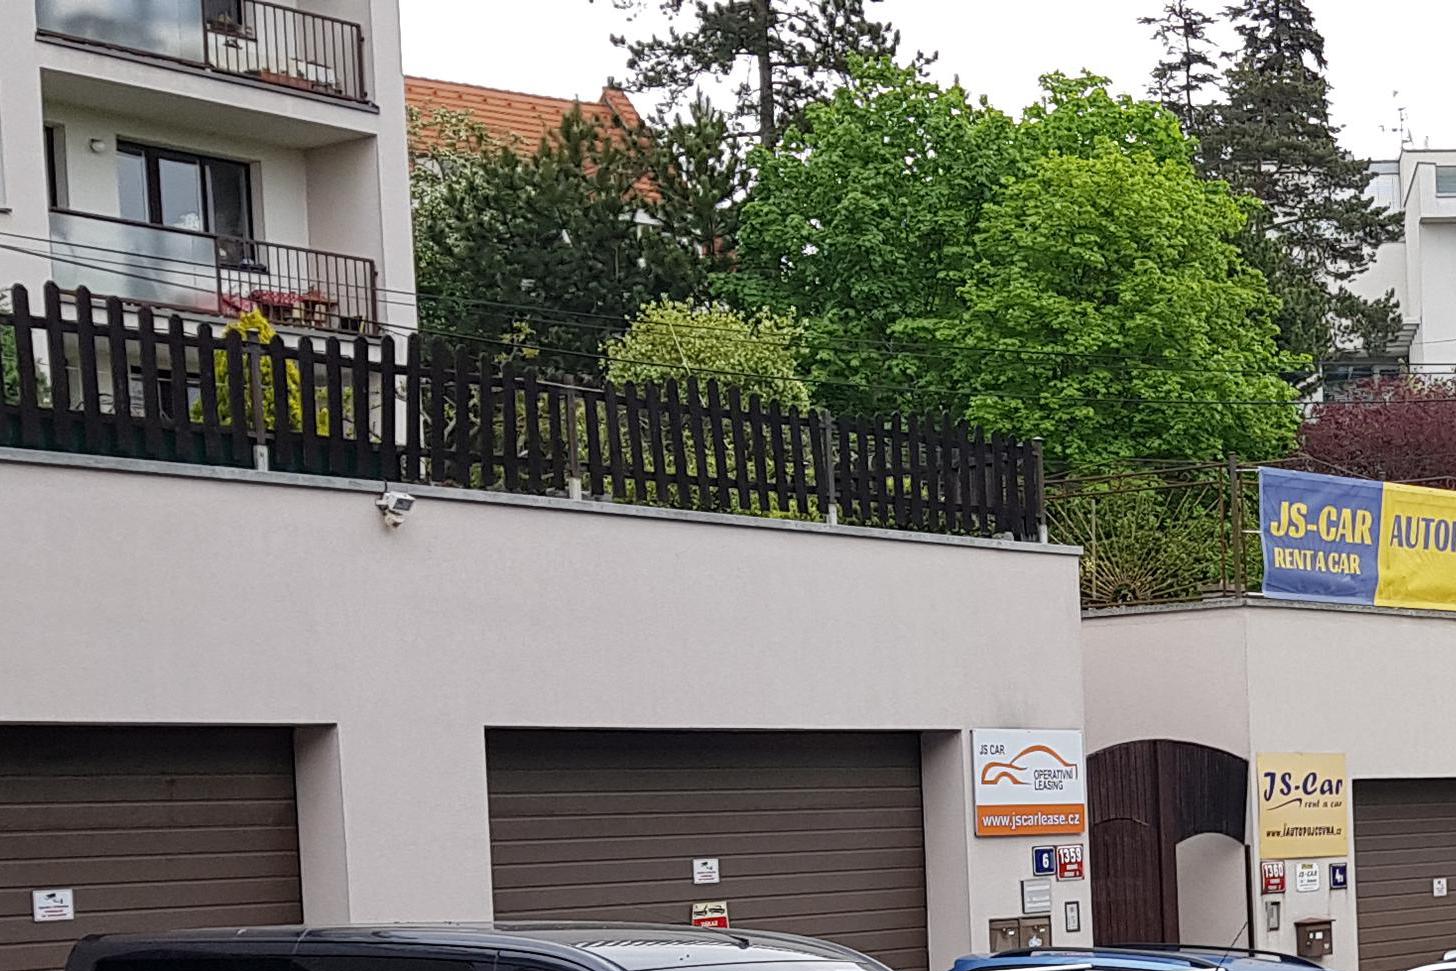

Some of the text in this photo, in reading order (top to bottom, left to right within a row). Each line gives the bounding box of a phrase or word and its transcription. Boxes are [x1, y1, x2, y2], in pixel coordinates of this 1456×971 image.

[1269, 501, 1372, 545] JS-CAR
[1274, 547, 1361, 575] RENT A CAR
[980, 744, 1005, 755] JS CAR
[1035, 780, 1064, 790] LEASING
[1264, 771, 1343, 801] JS-Car
[982, 812, 1080, 830] www.jscarlease.cz
[1042, 853, 1050, 868] 6
[1059, 848, 1082, 864] 1359
[1264, 864, 1284, 878] 1360
